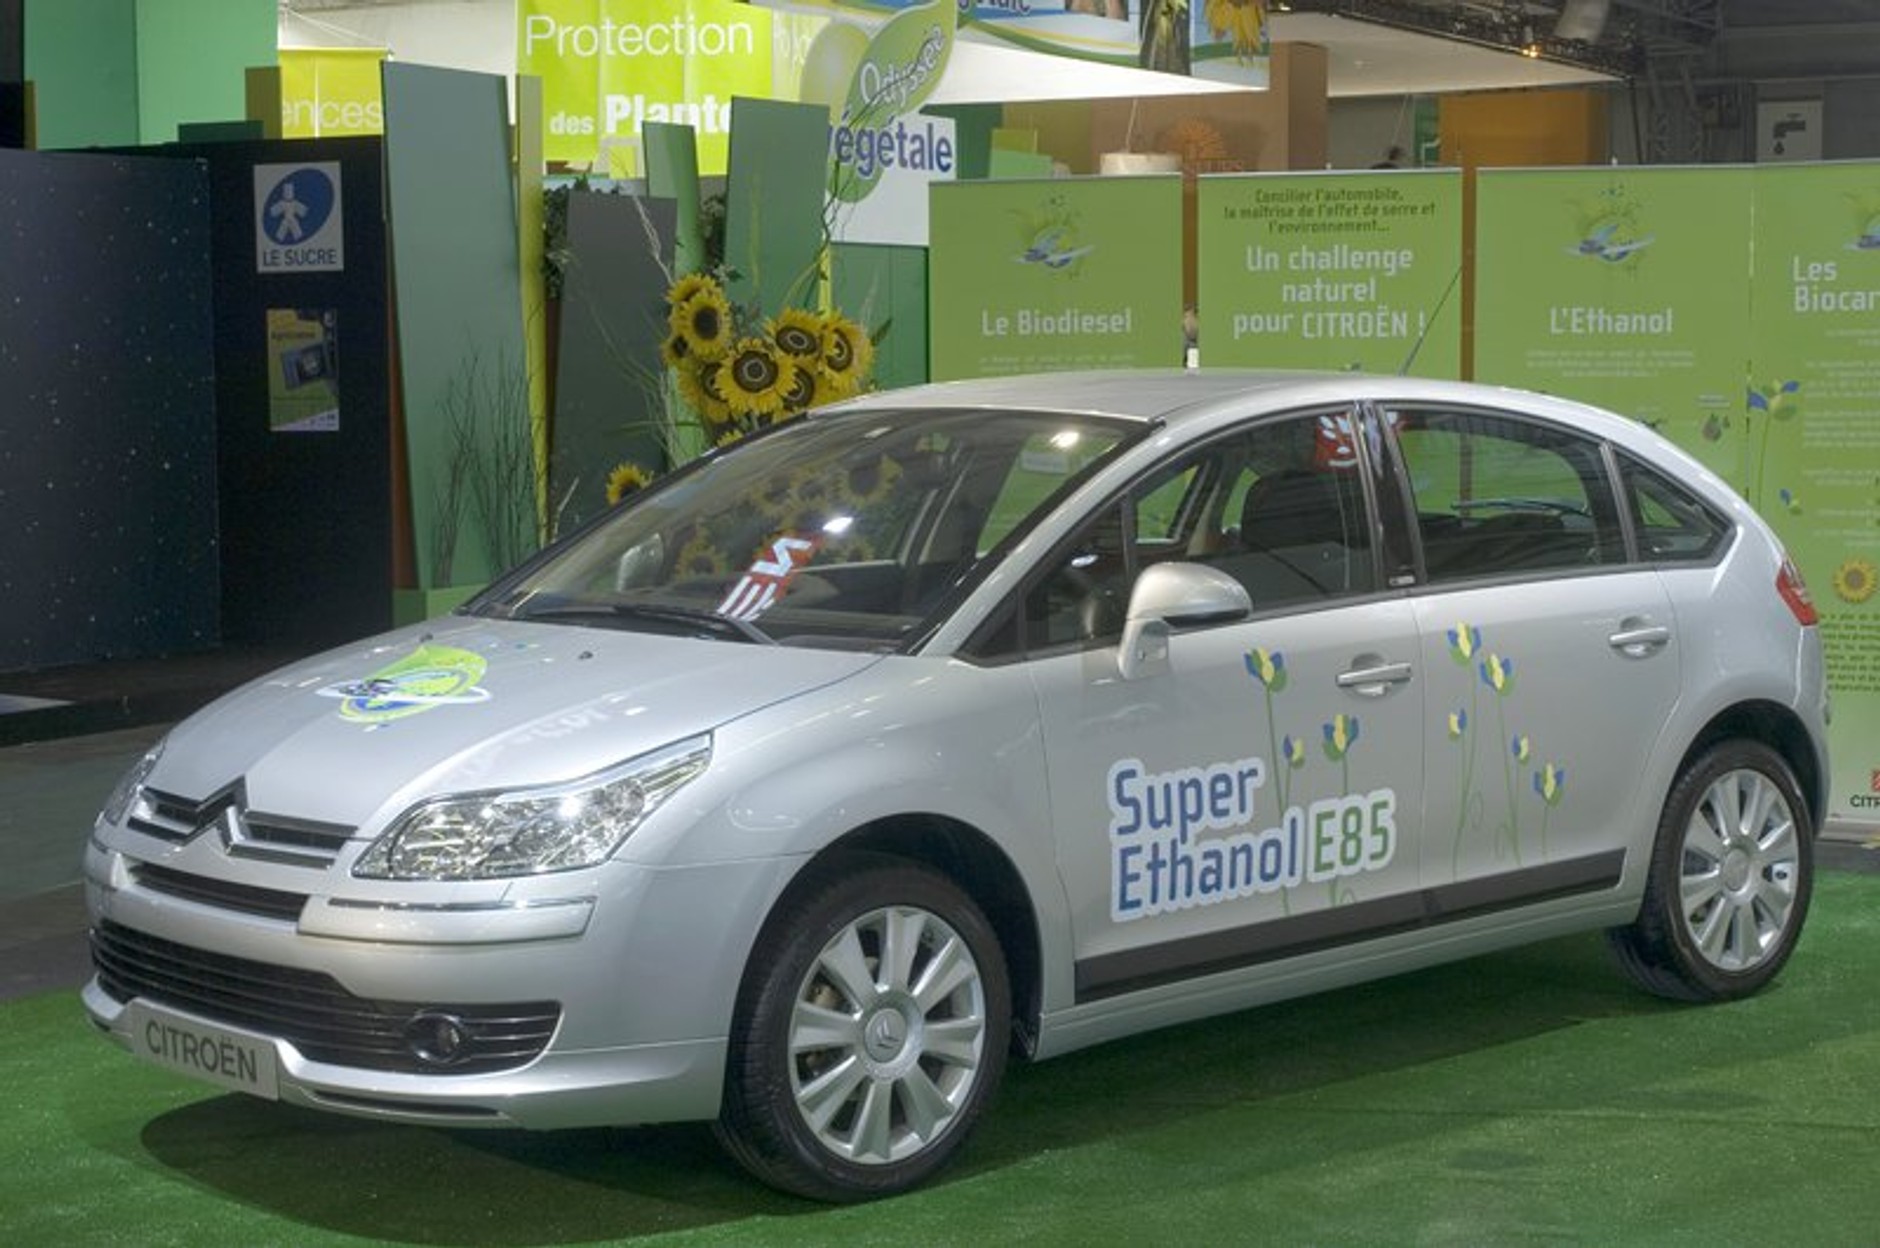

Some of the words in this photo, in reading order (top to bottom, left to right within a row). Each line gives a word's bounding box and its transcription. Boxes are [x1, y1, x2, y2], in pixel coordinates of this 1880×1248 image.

[525, 14, 754, 58] Protection
[549, 112, 594, 136] des
[828, 111, 953, 178] égétale
[1298, 204, 1315, 217] de
[1363, 202, 1379, 216] de
[1421, 202, 1435, 215] et
[263, 249, 280, 267] LE
[284, 248, 337, 266] SUCRE
[1246, 245, 1280, 272] Un
[1288, 244, 1414, 277] challenge
[1793, 254, 1837, 282] Les
[1282, 277, 1377, 302] naturel
[981, 309, 1009, 337] Le
[1017, 307, 1132, 335] Biodiesel
[1233, 312, 1294, 340] pour
[1302, 304, 1408, 339] CITROËN
[1550, 307, 1673, 334] L'Ethanol
[1114, 767, 1259, 845] Super
[1118, 816, 1297, 912] Ethanol
[1313, 800, 1389, 873] E85
[145, 1019, 258, 1083] CITROËN
